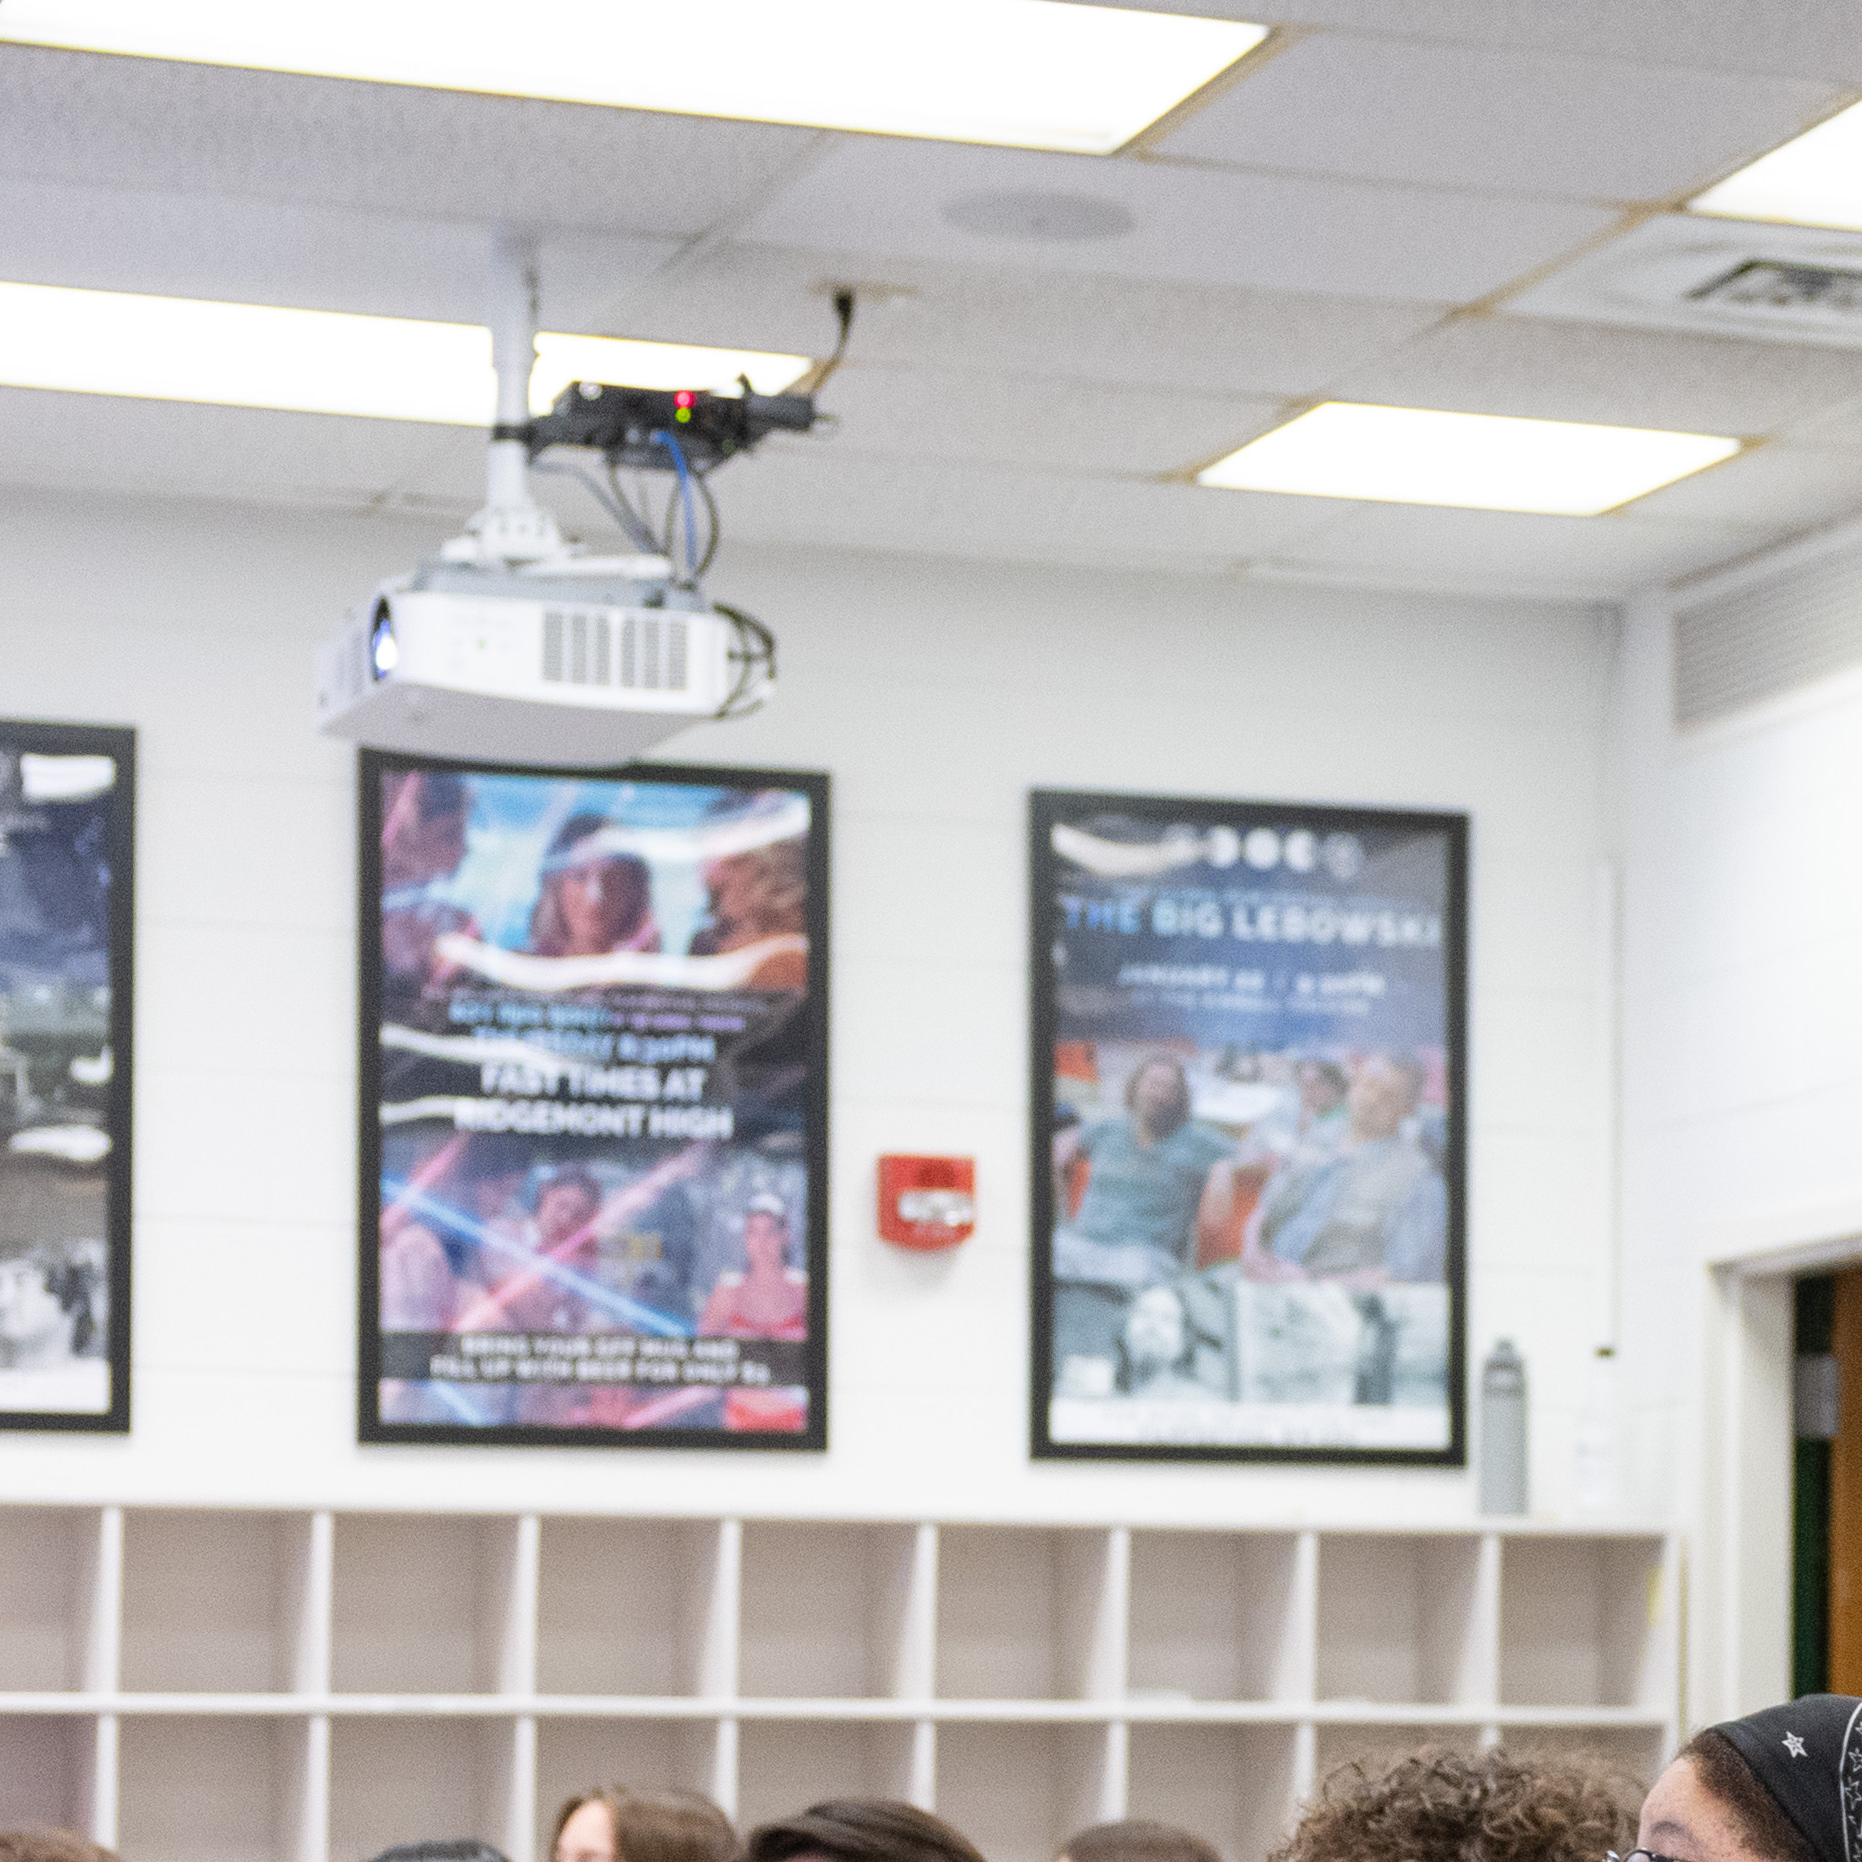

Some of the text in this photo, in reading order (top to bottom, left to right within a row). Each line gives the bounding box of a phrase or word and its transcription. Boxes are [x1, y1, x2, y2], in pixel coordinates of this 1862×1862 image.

[1061, 899, 1440, 949] THE BIG LEBOWSKI
[480, 1064, 707, 1101] FAST TIMES AT
[453, 1098, 733, 1140] RIDGEMONT HIGH
